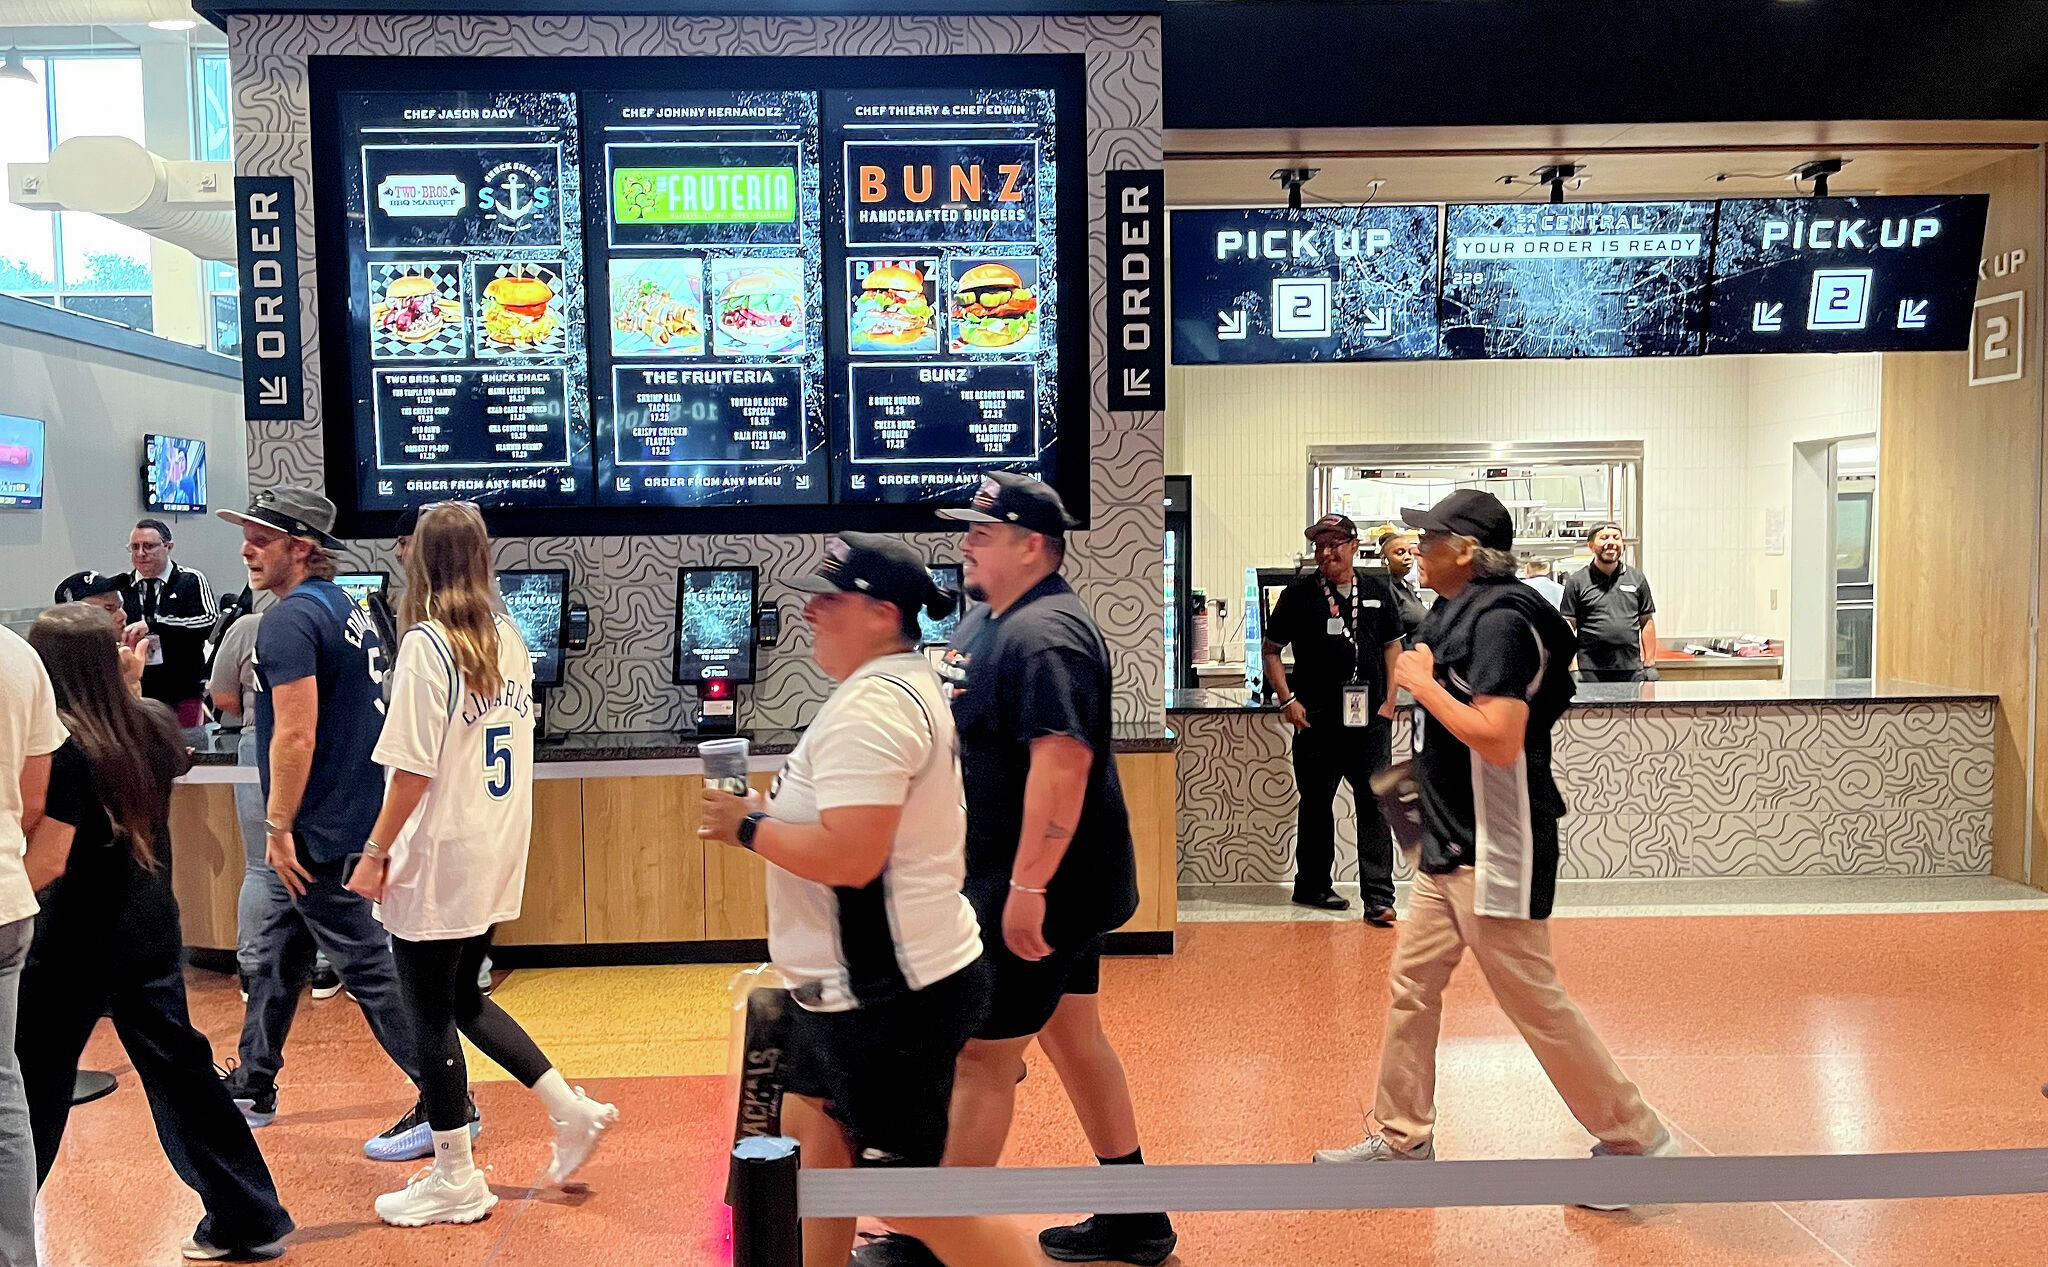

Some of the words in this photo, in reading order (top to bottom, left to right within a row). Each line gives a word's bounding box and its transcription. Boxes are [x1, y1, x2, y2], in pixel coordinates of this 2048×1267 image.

[404, 110, 437, 120] CHEF
[438, 109, 480, 120] JASON
[482, 108, 516, 119] DADY
[623, 108, 652, 118] CHEF
[656, 108, 706, 117] JOHNNY
[708, 107, 782, 117] HERNANDEZ
[856, 106, 886, 115] CHEF
[890, 106, 939, 115] THIERRY
[942, 106, 950, 115] &
[953, 106, 983, 115] CHEF
[986, 105, 1025, 115] EDWIN
[395, 186, 416, 198] TWO
[534, 186, 550, 208] S
[669, 174, 788, 211] FRUTERIA
[479, 187, 494, 209] S
[860, 210, 958, 222] HANDCRAFTED
[964, 209, 1025, 221] BURGERS
[1542, 215, 1643, 231] CENTRAL
[1762, 220, 1866, 249] PICK
[1879, 218, 1940, 248] UP
[1217, 230, 1320, 260] PICK
[1334, 228, 1391, 256] UP
[1463, 242, 1514, 254] YOUR
[1524, 241, 1592, 253] ORDER
[1602, 240, 1620, 252] IS
[1629, 239, 1696, 251] READY
[1122, 186, 1150, 350] ORDER
[1994, 249, 2026, 278] UP
[250, 191, 286, 358] ORDER
[1453, 273, 1484, 285] 228
[1829, 287, 1849, 309] 2
[1293, 296, 1311, 318] 2
[1985, 316, 2009, 360] 2
[386, 376, 407, 384] TWO
[409, 376, 439, 384] BROS.
[441, 375, 462, 383] BBQ
[482, 374, 515, 382] SHUCK
[518, 374, 550, 382] SHACK
[642, 371, 678, 384] THE
[682, 371, 774, 384] FRUITERIA
[920, 369, 967, 382] BUNZ
[637, 394, 663, 403] SHRIMP
[664, 394, 681, 403] BAJA
[894, 396, 920, 405] BURGER
[960, 391, 974, 400] THE
[1007, 390, 1025, 399] BUNZ
[730, 398, 752, 407] TORTA
[753, 398, 762, 407] DE
[764, 397, 788, 406] BISTEC
[979, 400, 1006, 409] BURGER
[648, 403, 671, 413] TACOS
[743, 407, 775, 416] ESPECIAL
[650, 413, 669, 422] 17.25
[632, 428, 657, 437] CRISPY
[658, 427, 688, 436] CHICKEN
[988, 424, 1018, 433] CHICKEN
[734, 431, 751, 440] BAJA
[752, 431, 768, 440] FISH
[768, 431, 786, 440] TACO
[882, 430, 908, 439] BURGER
[976, 433, 1010, 443] SANDWICH
[645, 437, 675, 446] FLAUTAS
[751, 441, 770, 450] 17.25
[652, 446, 670, 456] 17.25
[407, 481, 447, 491] ORDER
[451, 480, 484, 490] FROM
[486, 480, 510, 490] ANY
[512, 479, 546, 489] MENU
[645, 478, 684, 487] ORDER
[688, 477, 720, 486] FROM
[722, 477, 745, 486] ANY
[748, 476, 781, 486] MENU
[879, 475, 918, 485] ORDER
[921, 475, 954, 485] FROM
[955, 474, 979, 484] ANY
[482, 721, 514, 800] 5
